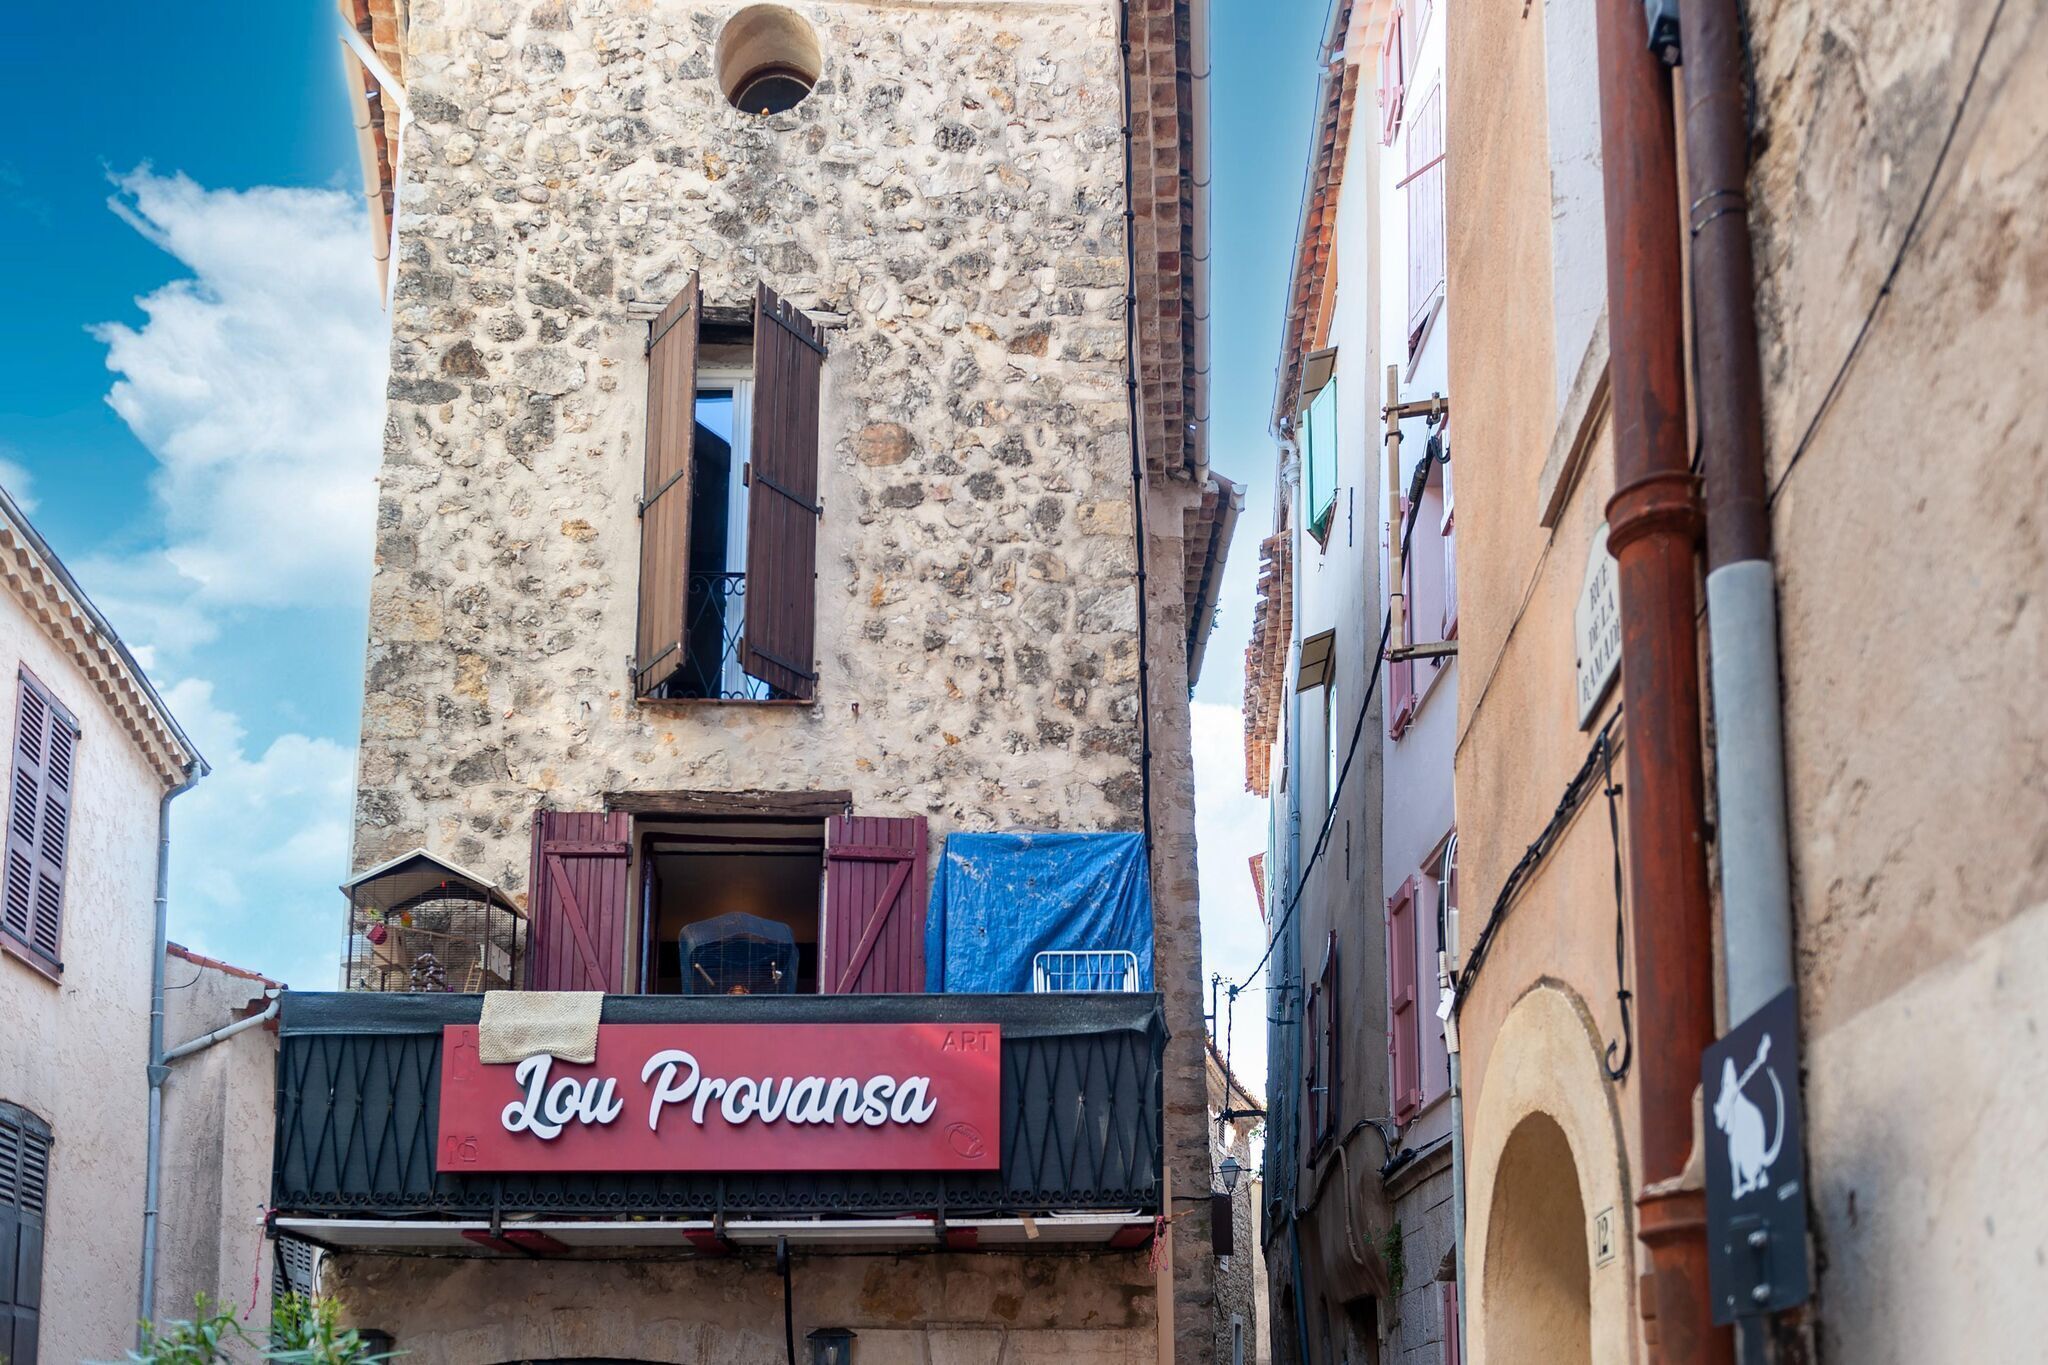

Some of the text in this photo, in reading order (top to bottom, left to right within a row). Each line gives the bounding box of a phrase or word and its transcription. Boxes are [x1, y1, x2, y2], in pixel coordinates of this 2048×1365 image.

[1590, 556, 1609, 611] RUE
[941, 1031, 993, 1052] ART
[502, 1049, 937, 1140] Lou Provansa
[1596, 1215, 1609, 1257] 12
